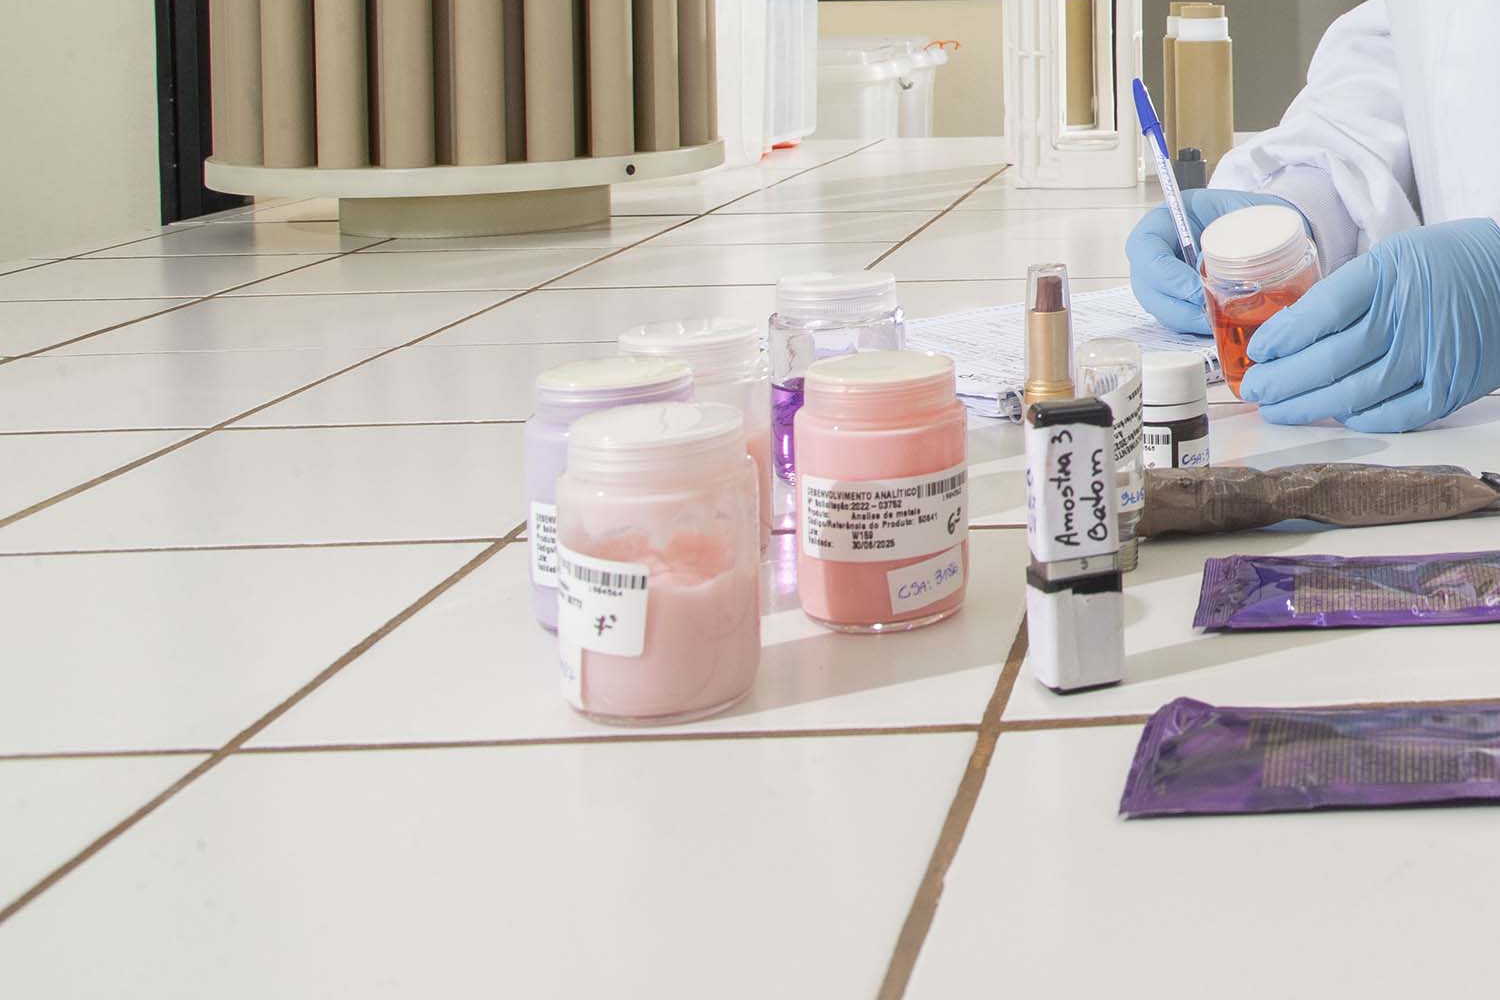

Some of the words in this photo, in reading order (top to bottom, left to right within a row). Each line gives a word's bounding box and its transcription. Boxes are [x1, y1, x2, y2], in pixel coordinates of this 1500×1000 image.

[1051, 430, 1073, 444] 3
[874, 487, 917, 501] ANALÍTICO
[1049, 451, 1080, 547] Amostra
[851, 501, 870, 511] 2022
[883, 510, 893, 519] de
[868, 521, 879, 530] do
